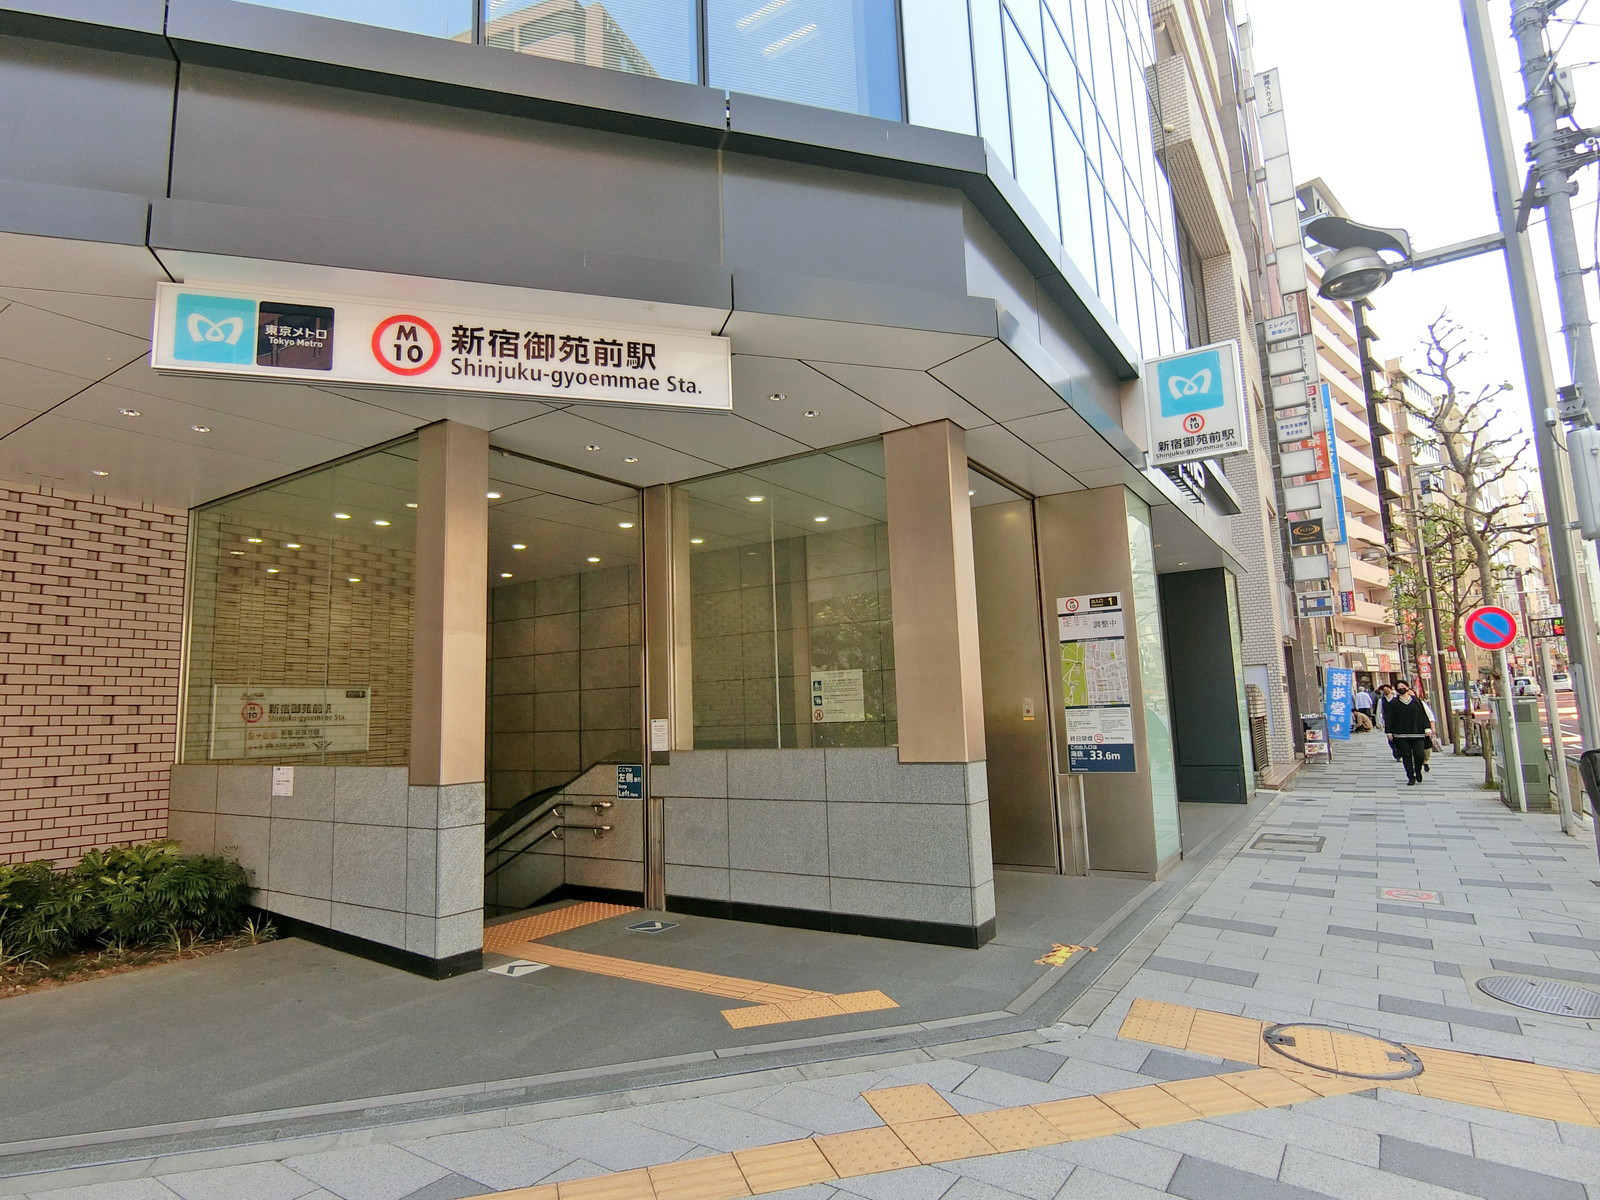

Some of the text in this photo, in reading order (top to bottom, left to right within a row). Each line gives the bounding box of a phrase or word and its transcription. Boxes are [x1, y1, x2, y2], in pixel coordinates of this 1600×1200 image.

[264, 324, 328, 340] 東京メトロ
[395, 325, 419, 342] M
[268, 336, 324, 348] Tokyo Metro
[451, 325, 656, 371] 新宿御苑前駅
[393, 342, 425, 365] 10
[451, 357, 702, 395] Shinjuku-gyoemmae Sta.
[1158, 429, 1234, 452] 新宿御苑前駅
[1156, 440, 1239, 459] Shinjuku-gyoemmae Sta.
[1107, 596, 1113, 606] 1
[1093, 619, 1117, 629] 調整中
[248, 711, 258, 719] 10
[1089, 750, 1121, 760] 33.6m
